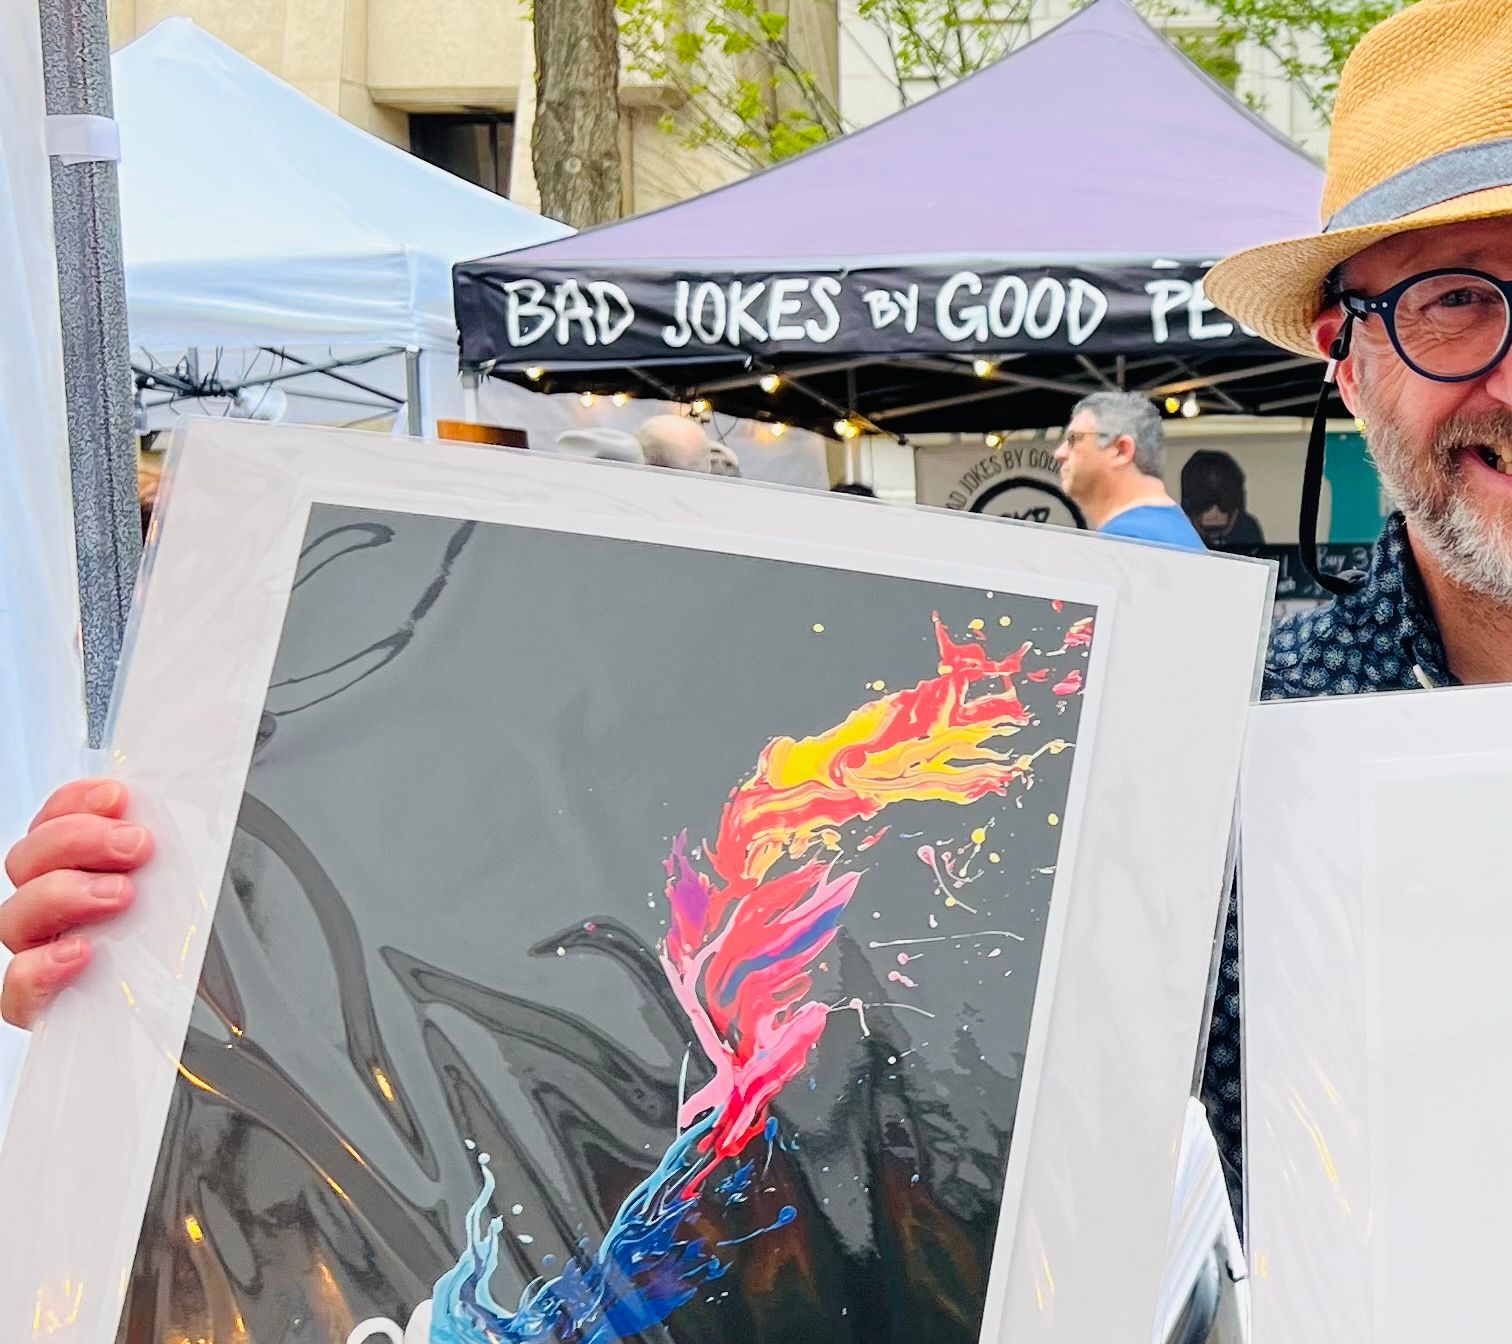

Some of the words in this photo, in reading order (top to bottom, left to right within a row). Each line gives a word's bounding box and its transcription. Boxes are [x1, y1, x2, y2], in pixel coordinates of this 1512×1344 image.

[503, 278, 635, 347] BAD
[661, 276, 842, 348] JOKES
[863, 282, 919, 333] BY
[935, 270, 1108, 346] GOOD
[963, 457, 1003, 495] JOKES
[1003, 448, 1025, 469] BY
